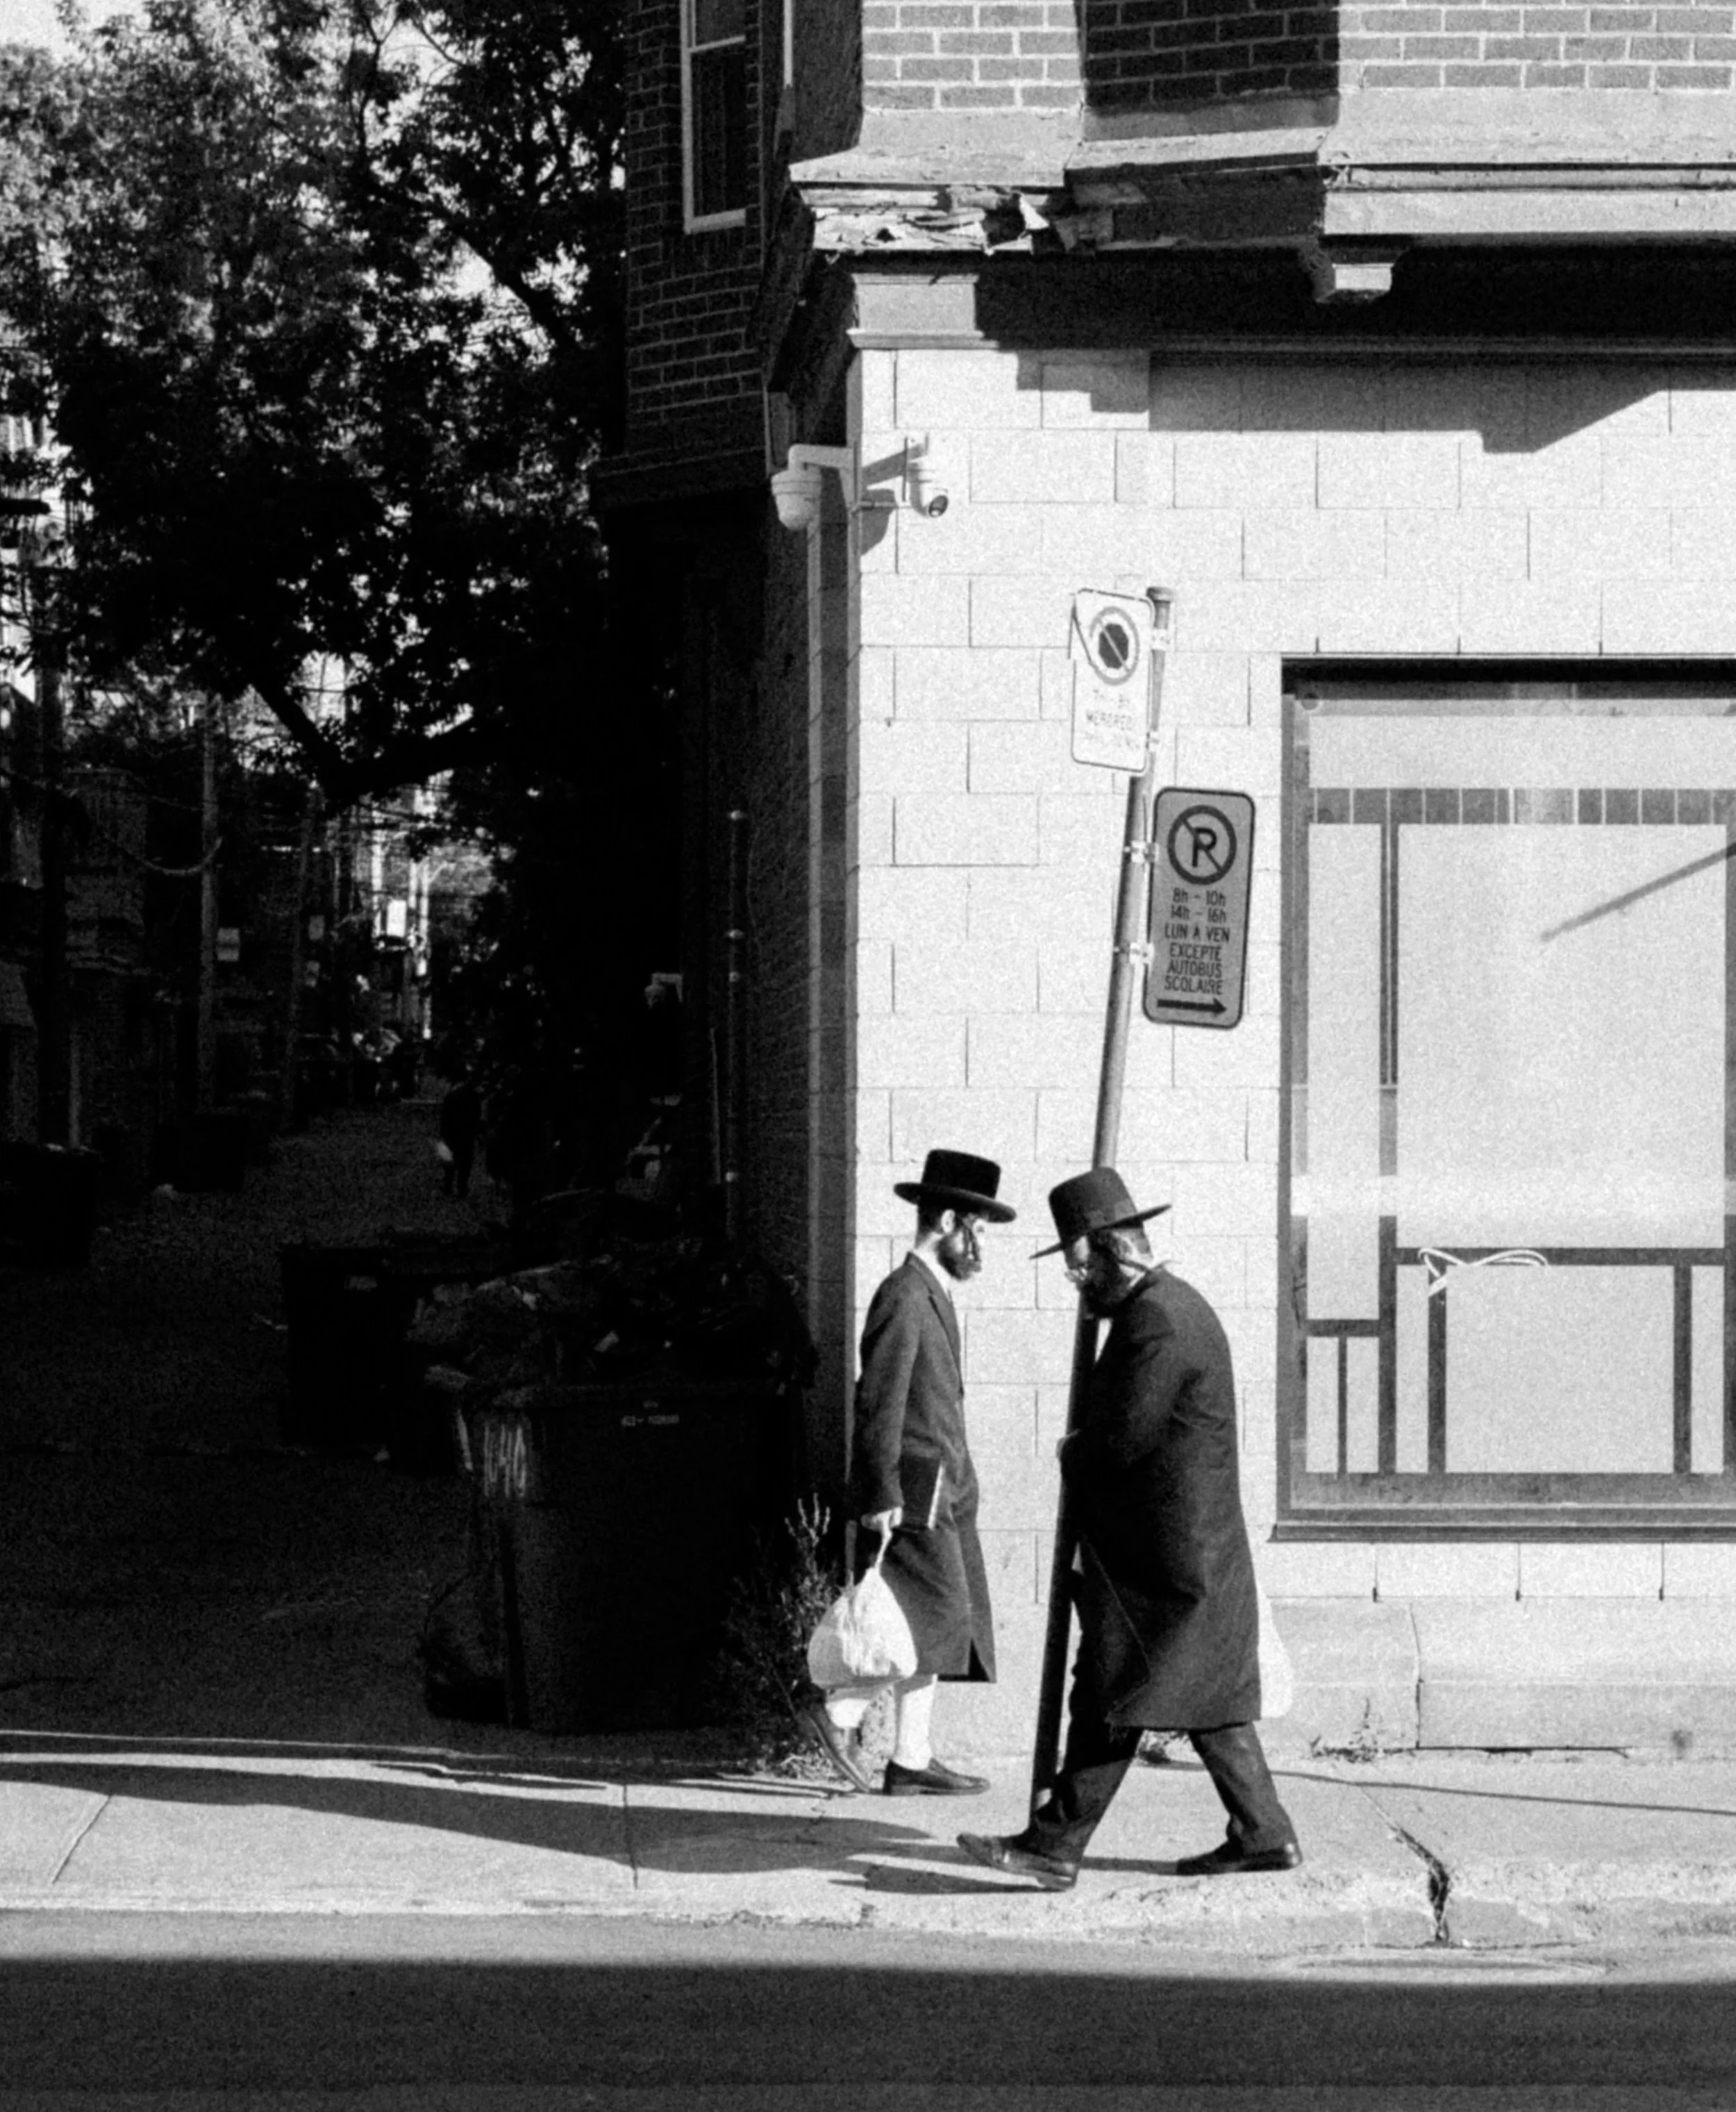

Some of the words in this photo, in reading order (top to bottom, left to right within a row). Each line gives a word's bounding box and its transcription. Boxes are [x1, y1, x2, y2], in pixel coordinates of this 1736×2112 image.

[1192, 826, 1217, 868] P
[1172, 887, 1189, 904] 8h
[1205, 889, 1226, 907] 10h
[1170, 904, 1190, 921] 14h
[1165, 922, 1189, 940] LUN
[1205, 924, 1230, 943] VEN
[1167, 959, 1223, 979] AUTOBUS
[1164, 974, 1224, 996] SCOLAIRE
